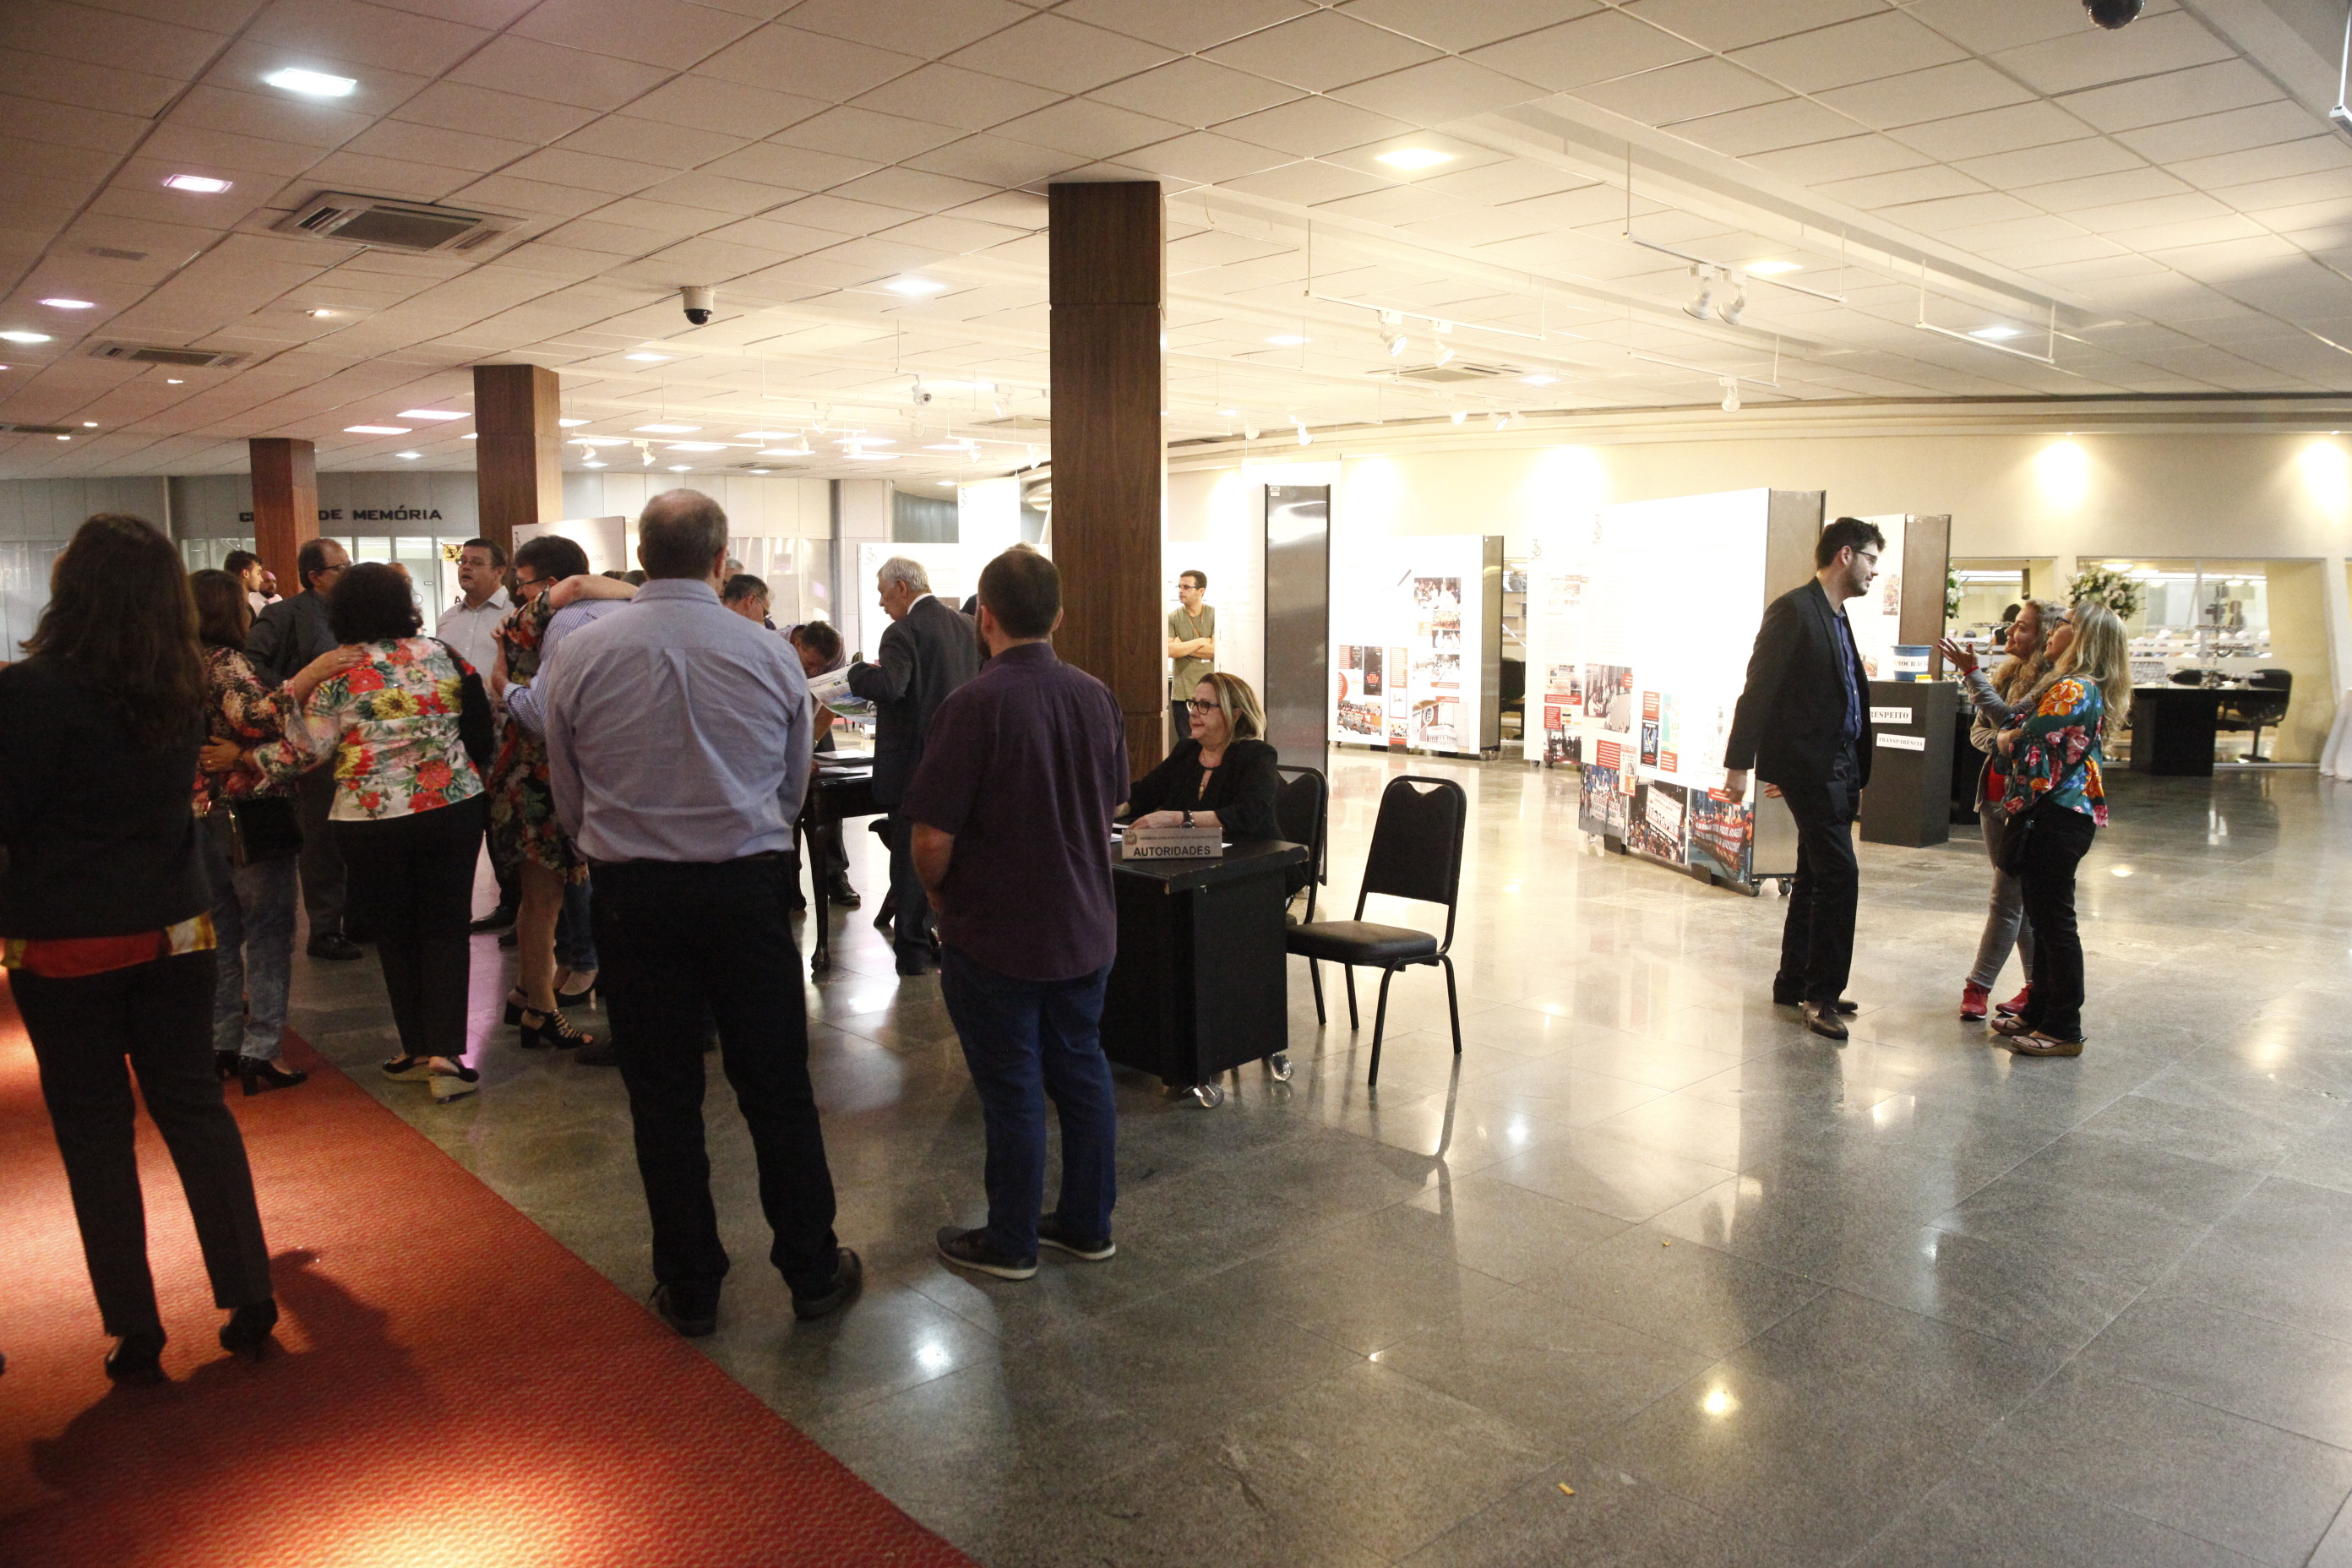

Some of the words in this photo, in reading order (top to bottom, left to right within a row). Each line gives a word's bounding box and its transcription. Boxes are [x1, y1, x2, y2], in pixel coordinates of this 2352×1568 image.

[318, 509, 343, 520] DE
[352, 504, 443, 520] MEMÓRIA
[1870, 710, 1908, 719] RESPEITO
[1134, 846, 1211, 857] AUTORIDADES
